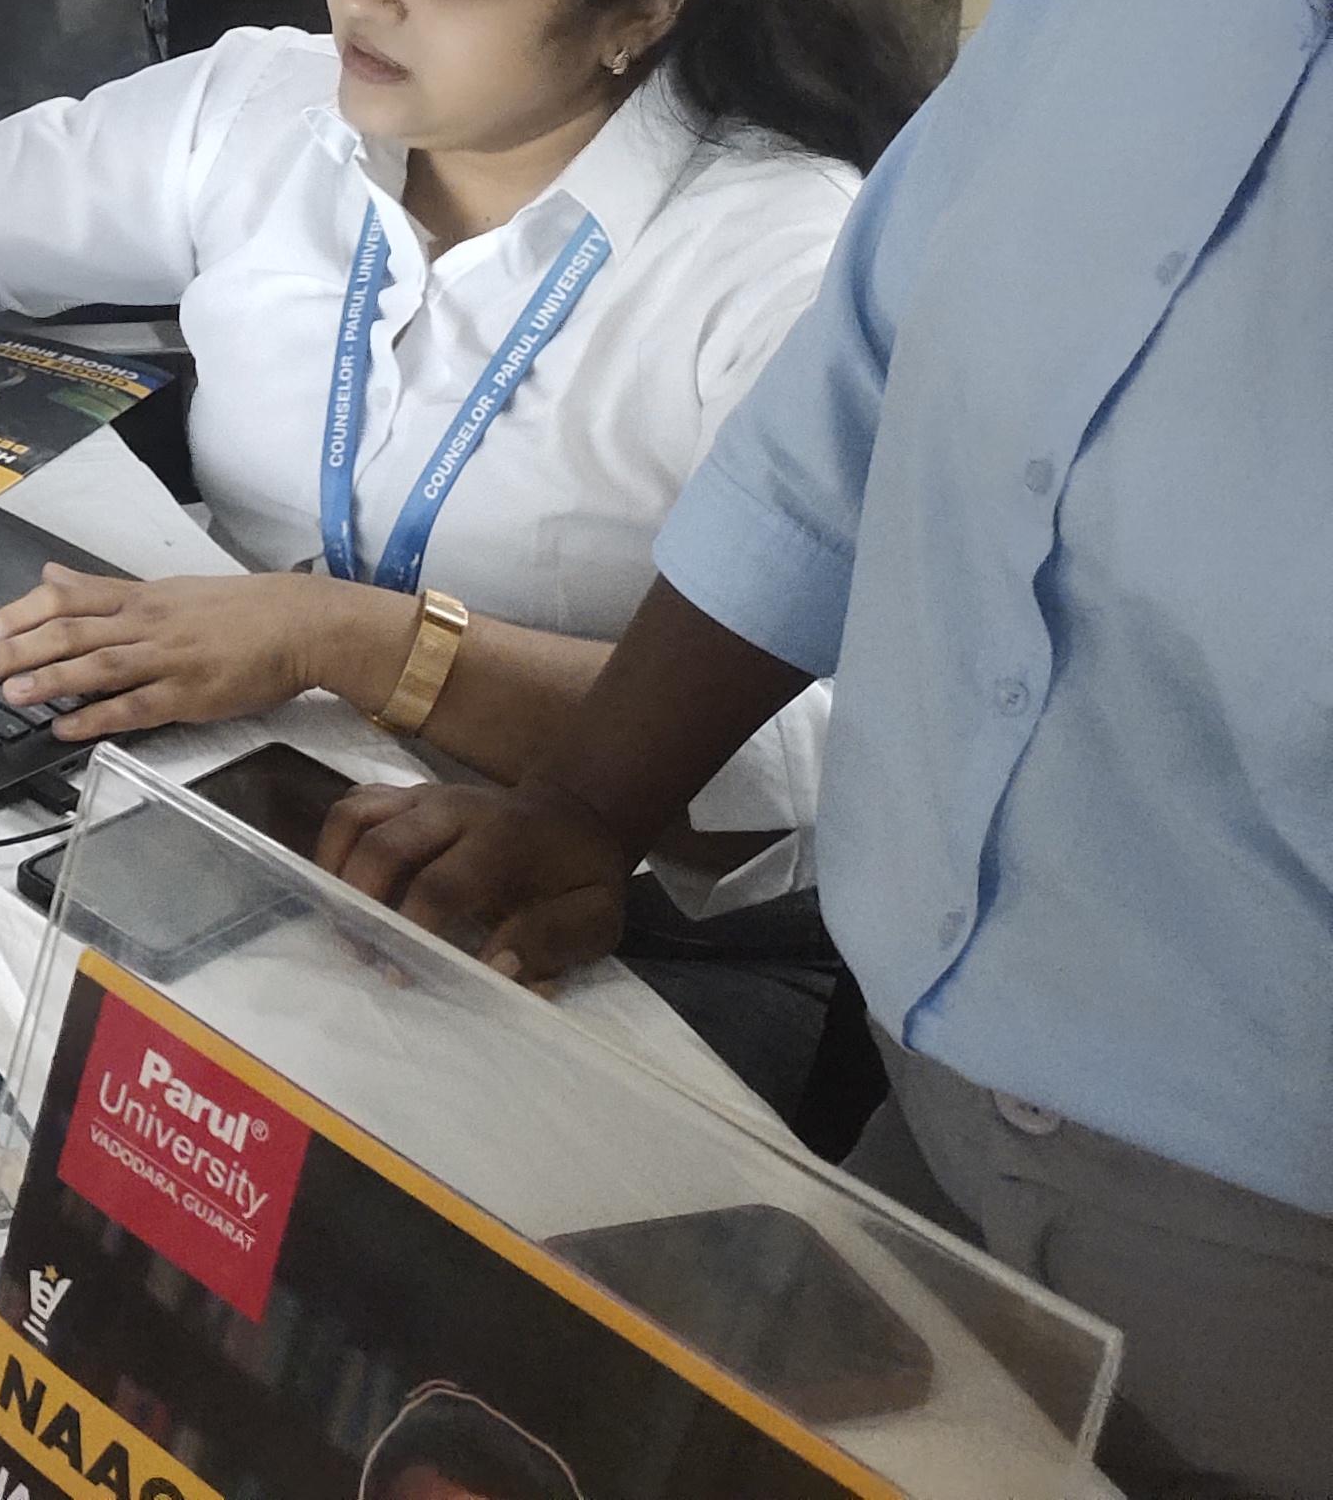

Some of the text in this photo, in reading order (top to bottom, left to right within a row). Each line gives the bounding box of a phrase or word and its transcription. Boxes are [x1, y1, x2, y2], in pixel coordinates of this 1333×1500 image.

[58, 354, 140, 380] CHOOSE
[329, 355, 356, 468] COUNSELOR
[344, 284, 369, 343] PARUL
[424, 395, 496, 501] COUNSELOR
[492, 333, 539, 387] PARUL
[531, 227, 608, 334] UNIVERSITY
[99, 1071, 268, 1220] University
[138, 1047, 250, 1153] Parul
[181, 1192, 255, 1252] GUJARAT
